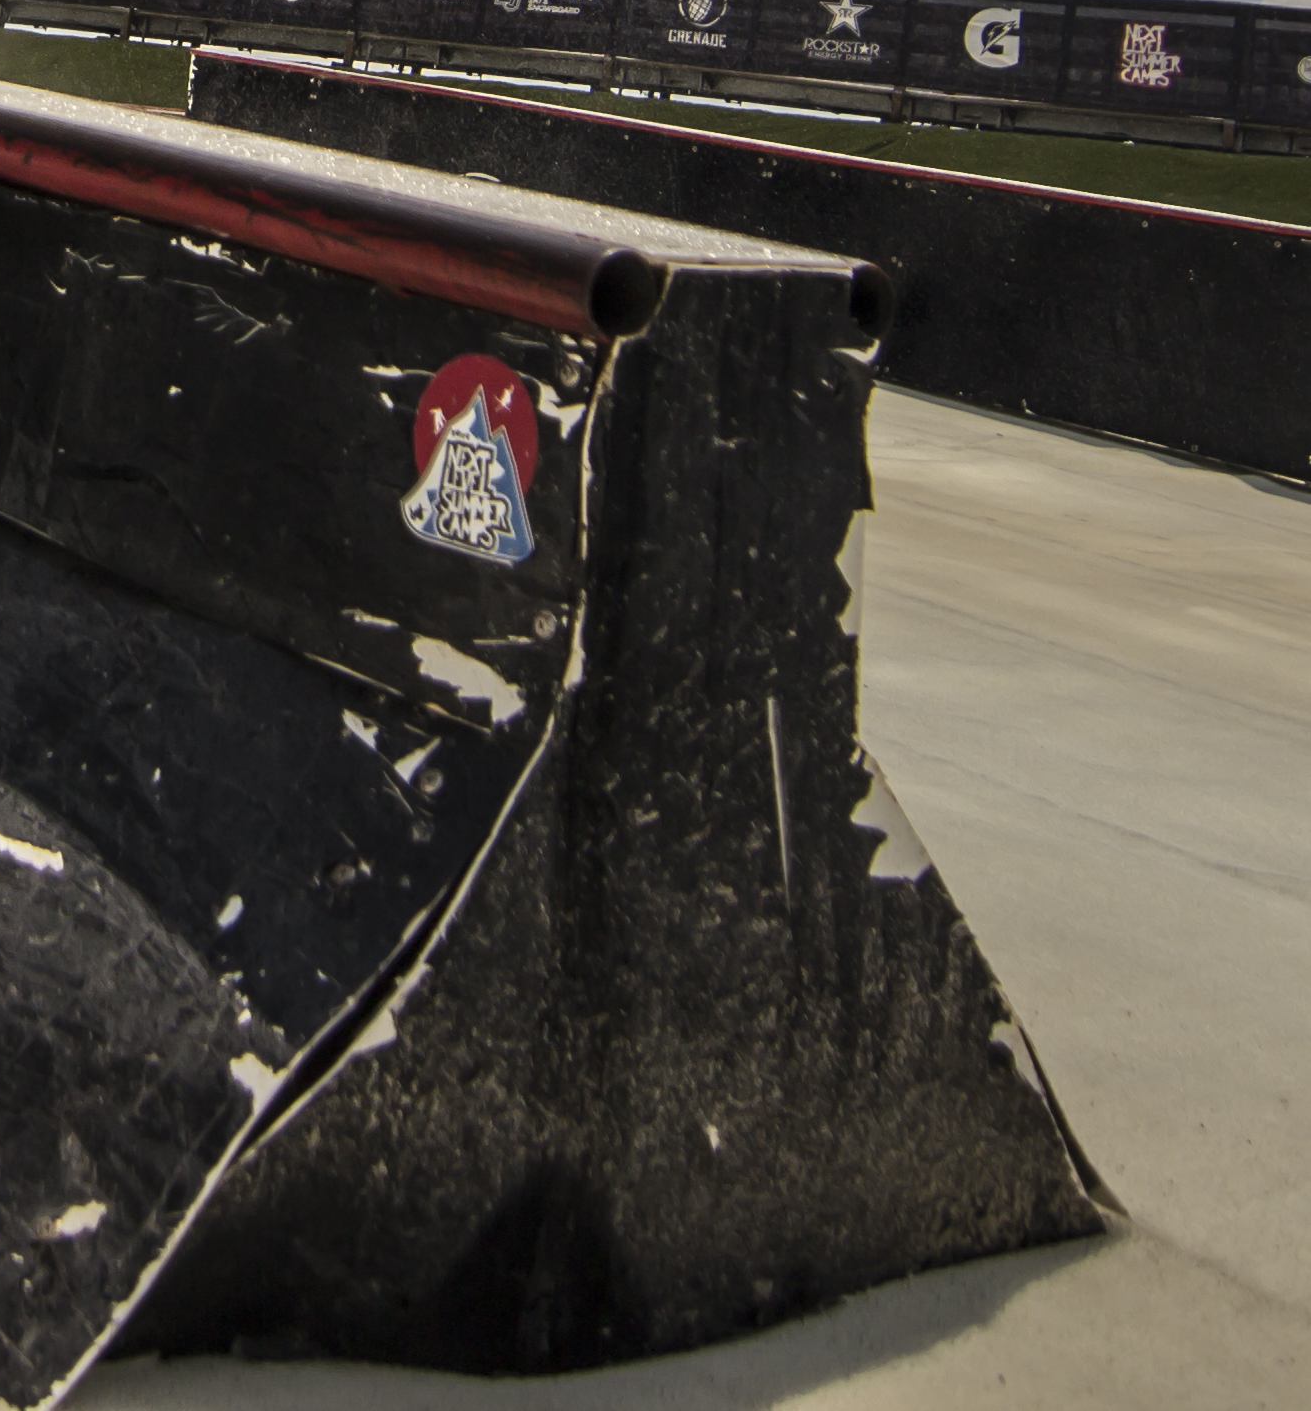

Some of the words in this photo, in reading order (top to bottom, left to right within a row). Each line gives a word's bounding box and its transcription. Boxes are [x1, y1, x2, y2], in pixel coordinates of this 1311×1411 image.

[668, 29, 727, 49] GRENADE
[1125, 23, 1166, 43] NEXT
[1121, 52, 1181, 73] SUMMER
[1120, 67, 1170, 86] CAMPS
[446, 443, 492, 476] NEXT
[439, 487, 509, 530] SUMMER
[438, 511, 493, 548] CAMPS
